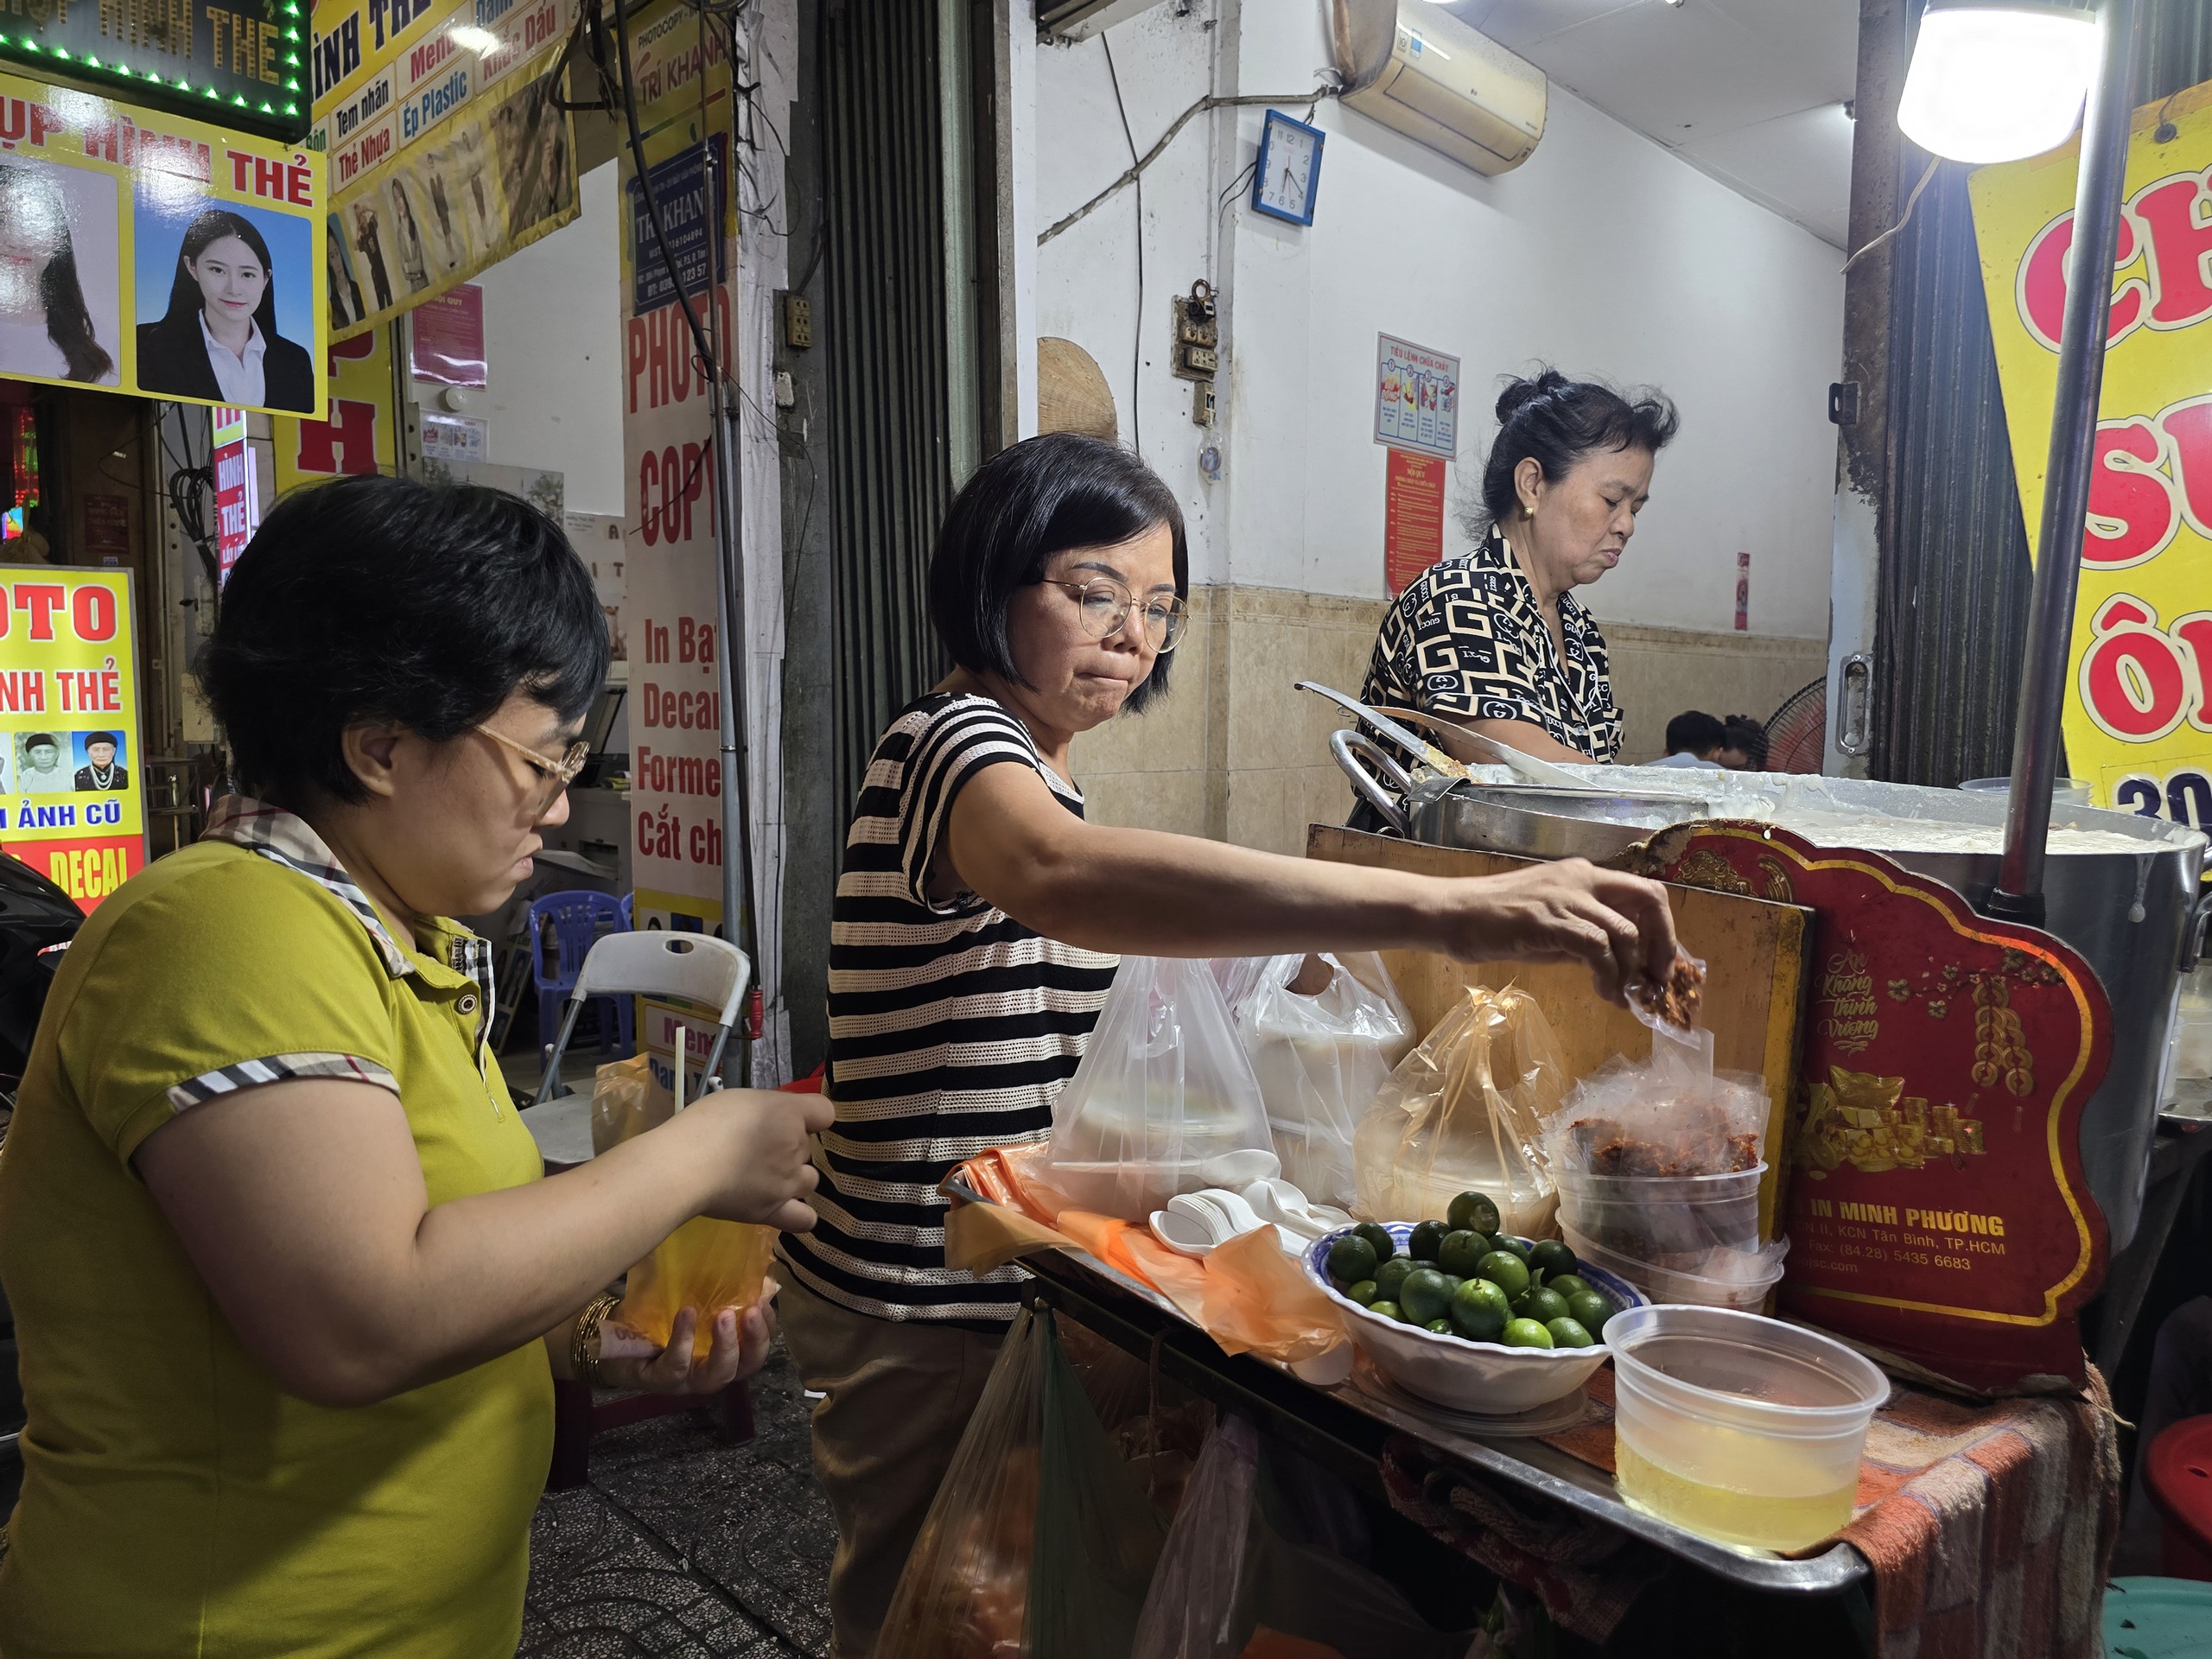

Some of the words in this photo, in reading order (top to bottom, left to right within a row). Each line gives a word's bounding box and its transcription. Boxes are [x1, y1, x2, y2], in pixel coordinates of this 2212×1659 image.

[207, 0, 280, 85] THẺ
[525, 0, 556, 51] Dấu
[639, 10, 683, 48] PHOTOCOPY
[640, 57, 662, 105] TRÍ
[666, 28, 728, 92] KHANH
[336, 104, 359, 138] Tem
[361, 77, 389, 121] nhãn
[404, 97, 418, 138] Ép
[422, 70, 467, 125] Plastic
[226, 152, 314, 208] THẺ
[339, 142, 359, 182] Thẻ
[361, 128, 390, 164] Nhựa
[663, 187, 705, 232] KHAN
[221, 491, 246, 537] THẺ
[0, 584, 118, 641] TO
[1418, 617, 1440, 631] GUCCI
[1560, 594, 1577, 616] GUCCI
[645, 619, 670, 664] In
[678, 616, 717, 674] Bạ
[56, 657, 120, 711] THẺ
[638, 746, 721, 798] Forme
[18, 799, 75, 829] ẢNH
[86, 799, 121, 825] CŨ
[638, 803, 681, 861] Cắt
[1815, 973, 1872, 998] Khang
[1810, 1198, 1833, 1218] IN
[1839, 1201, 1898, 1225] MINH
[1905, 1207, 2005, 1236] PHƯƠNG
[1839, 1225, 1866, 1241] KCN
[1872, 1229, 1897, 1243] Tân
[1904, 1233, 1939, 1249] Bình,
[1945, 1236, 2006, 1255] TP.HCM
[1808, 1239, 1834, 1254] Fax:
[1840, 1244, 1888, 1262] (84.28)
[1893, 1249, 1929, 1265] 5435
[1934, 1255, 1971, 1270] 6683
